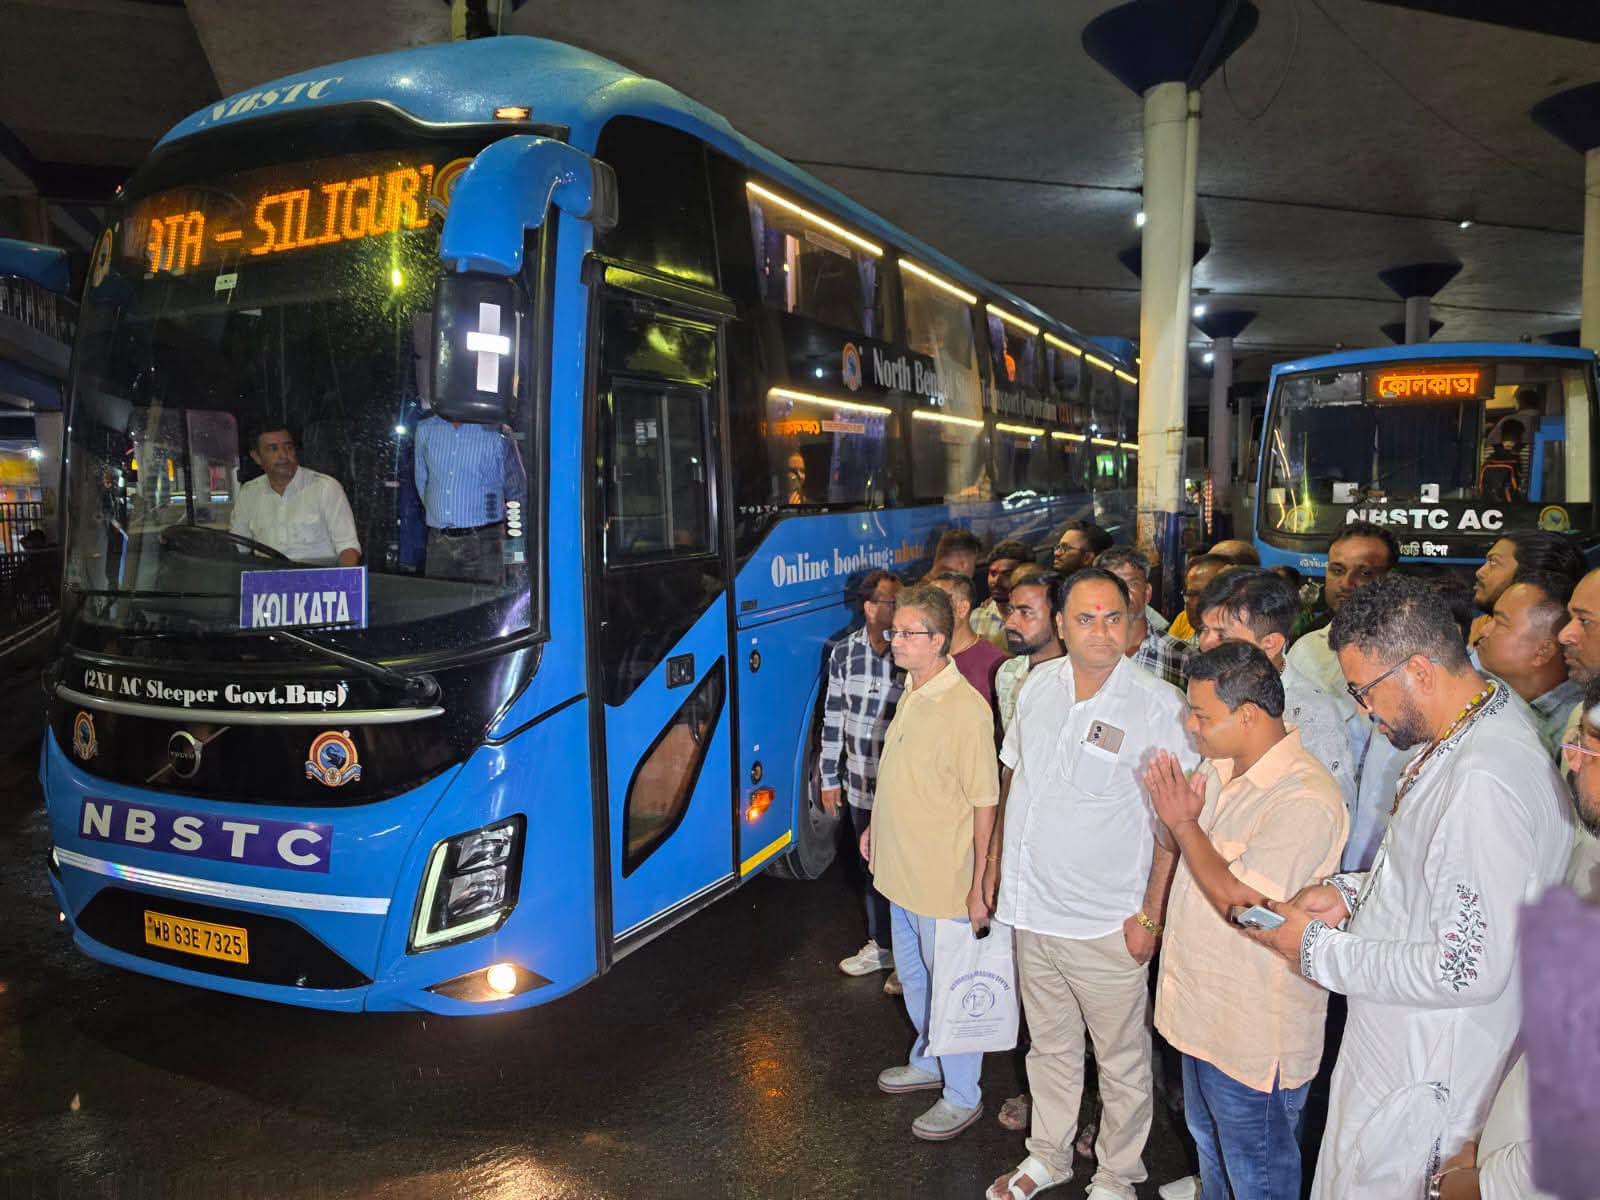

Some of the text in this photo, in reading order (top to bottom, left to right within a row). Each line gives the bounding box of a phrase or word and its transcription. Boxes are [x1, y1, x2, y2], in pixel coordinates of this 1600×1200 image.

[199, 77, 343, 126] NBSTC
[872, 347, 911, 392] North
[1379, 373, 1479, 396] কোলকাতা
[1345, 508, 1503, 530] NBSTC AC
[771, 553, 829, 588] Online
[252, 591, 350, 628] KOLKATA
[119, 676, 143, 697] AC
[146, 679, 218, 707] Sleeper
[153, 919, 242, 956] WB 63E 7325
